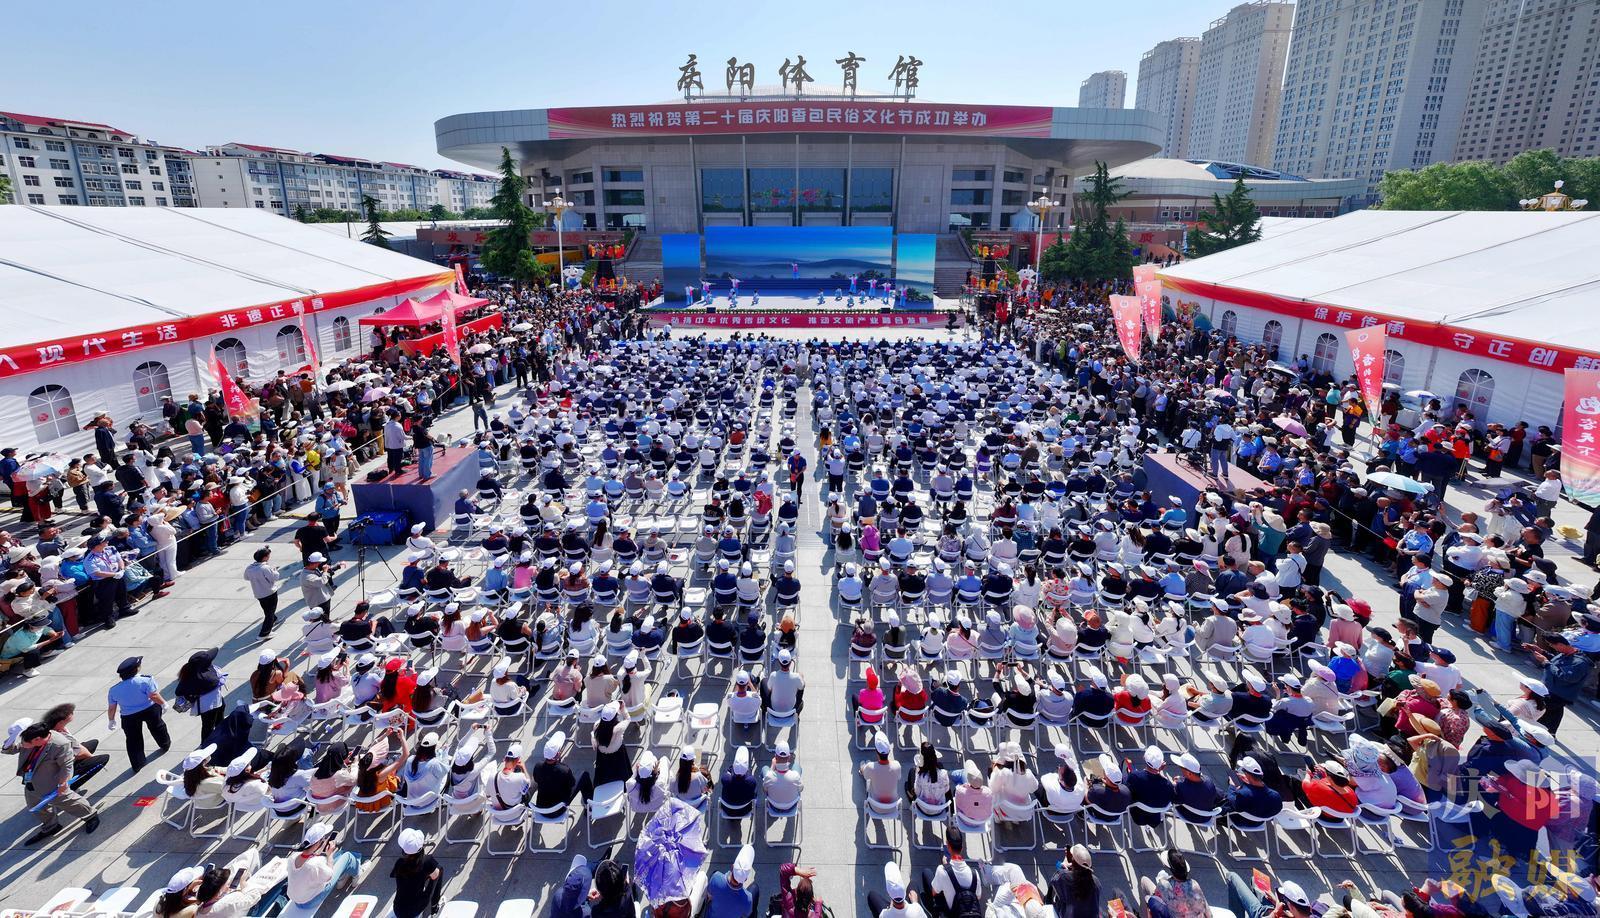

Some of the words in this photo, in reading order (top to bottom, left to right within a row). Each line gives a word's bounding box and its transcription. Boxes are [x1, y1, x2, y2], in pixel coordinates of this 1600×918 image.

[677, 51, 924, 91] 庆阳体育馆
[611, 107, 988, 127] 热烈祝贺第二十届庆阳香包民俗文化节成功举办
[670, 316, 791, 326] 弘扬中华优秀传统文化
[807, 316, 928, 326] 推动文旅产业融合发展
[1575, 395, 1600, 456] 包容天下
